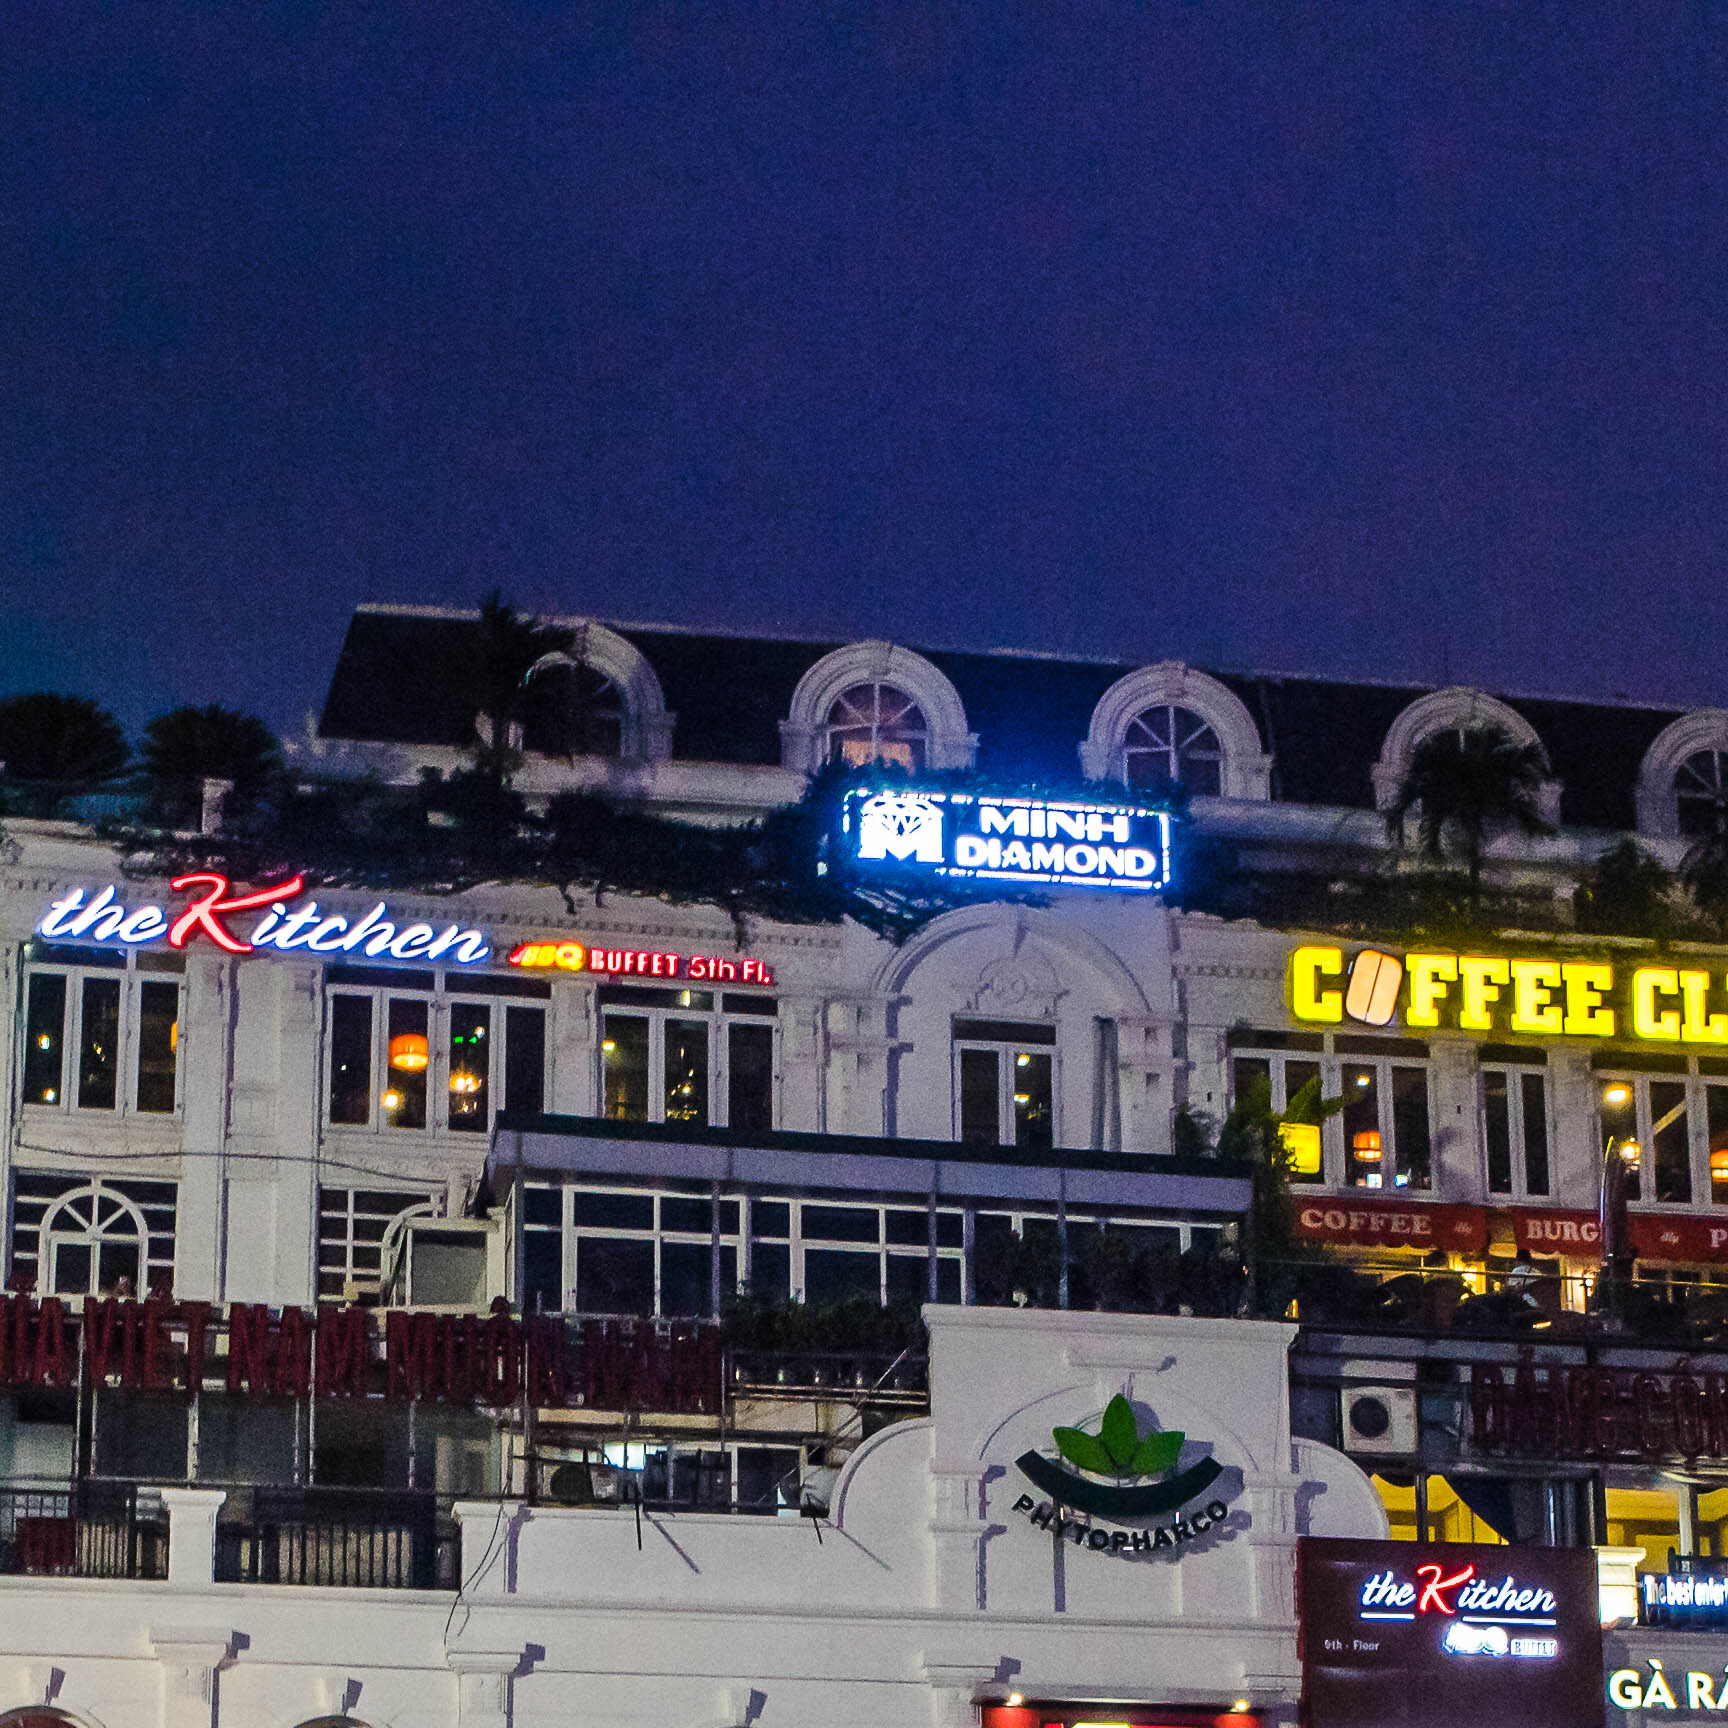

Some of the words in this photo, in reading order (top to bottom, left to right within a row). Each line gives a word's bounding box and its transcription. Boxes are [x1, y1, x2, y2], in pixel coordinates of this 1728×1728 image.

[980, 807, 1128, 843] MINH
[956, 837, 1156, 877] DIAMOND
[39, 885, 168, 943] the
[169, 872, 490, 964] Kitchen
[590, 948, 679, 977] BUFFET
[688, 954, 735, 981] 5th
[1289, 945, 1619, 1036] COFFEE
[1299, 1206, 1432, 1237] COFFEE
[1525, 1218, 1603, 1242] BURG
[1011, 1493, 1230, 1552] PHYTOPHARCO
[1360, 1570, 1416, 1609] the
[1416, 1561, 1557, 1616] Kitchen
[1667, 1575, 1694, 1606] best
[1353, 1639, 1380, 1651] Floor
[1608, 1658, 1676, 1711] GÀ
